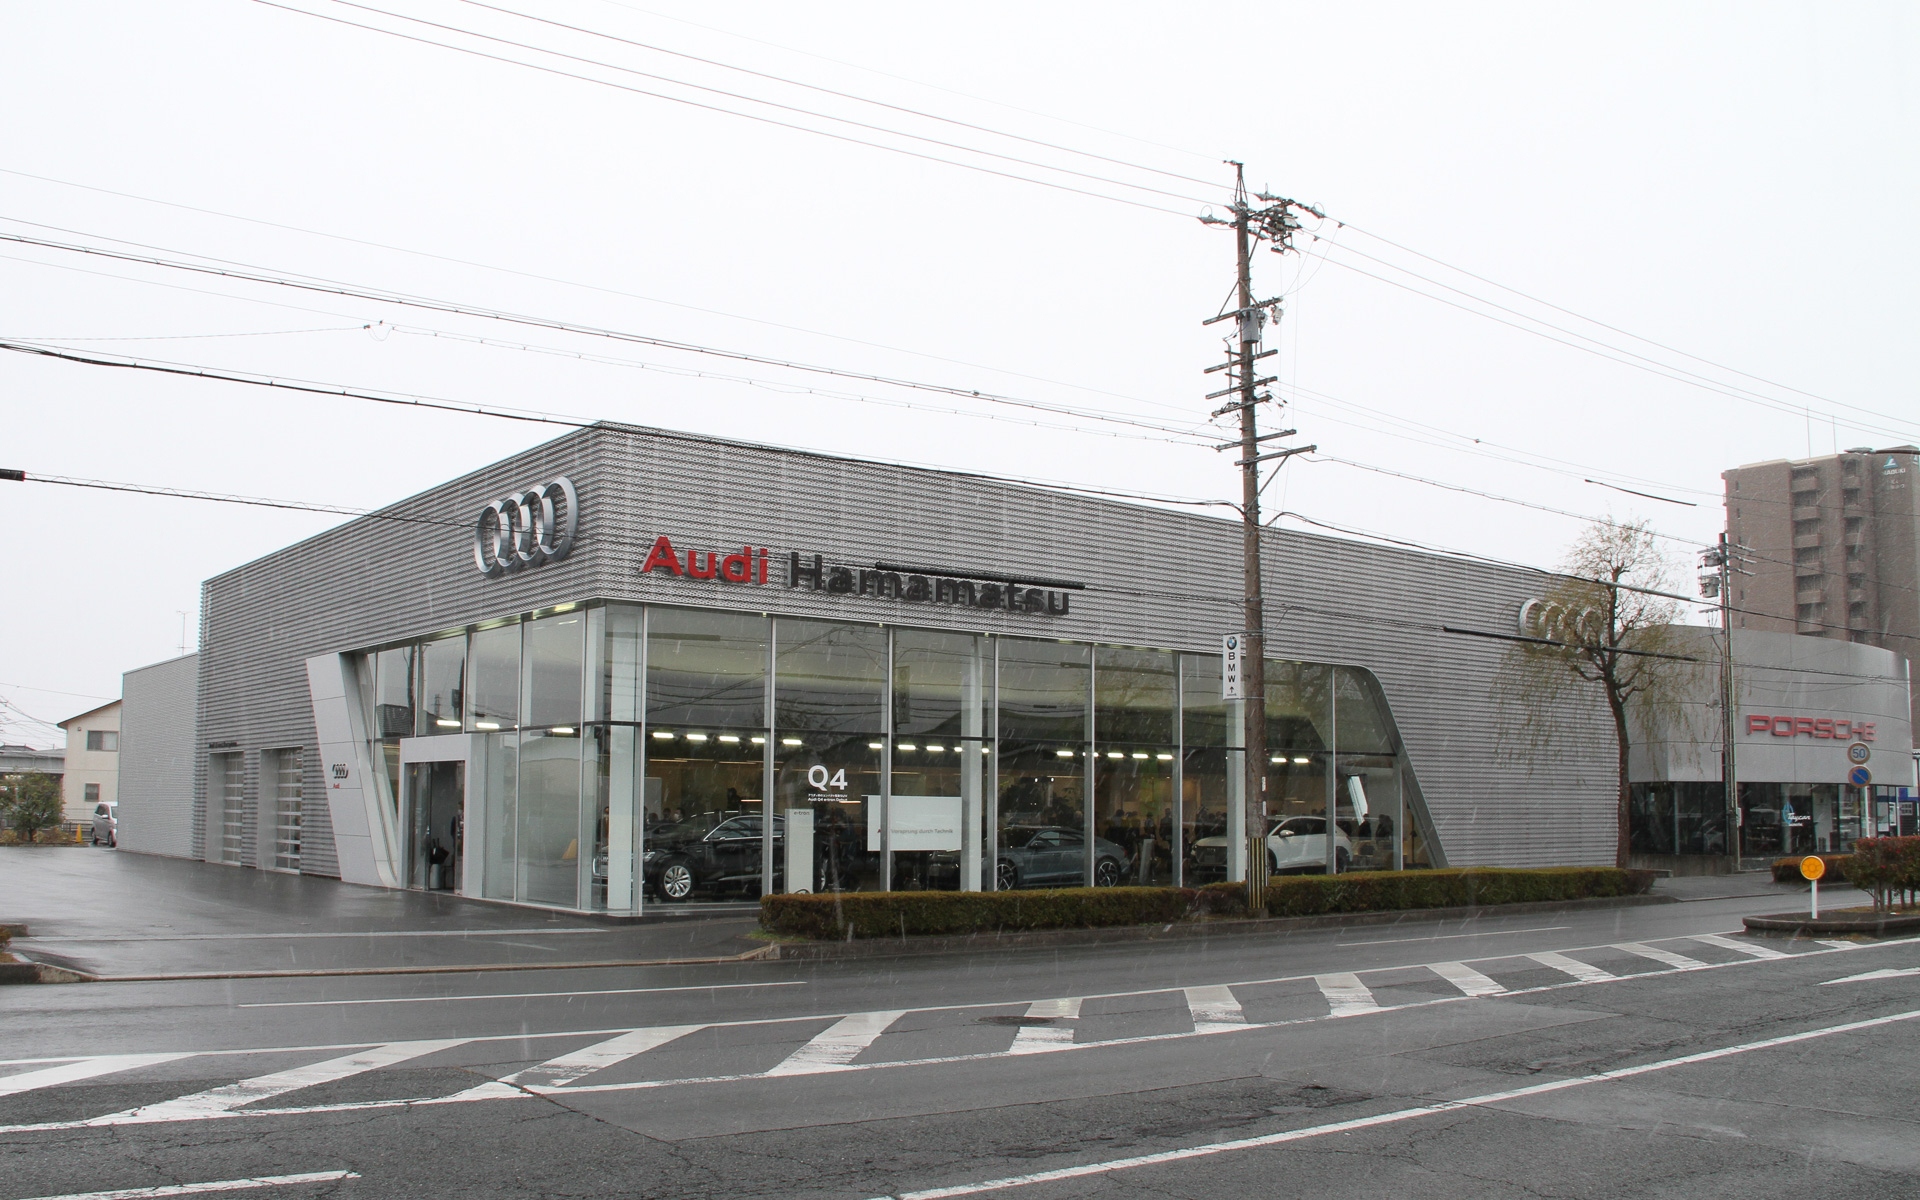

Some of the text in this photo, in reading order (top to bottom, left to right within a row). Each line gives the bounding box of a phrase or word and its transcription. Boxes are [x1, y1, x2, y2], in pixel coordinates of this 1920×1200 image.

[639, 536, 1069, 615] Audi Hamamatsu
[1746, 715, 1878, 741] PORSCHE
[1852, 748, 1866, 758] 50
[808, 764, 848, 791] Q4
